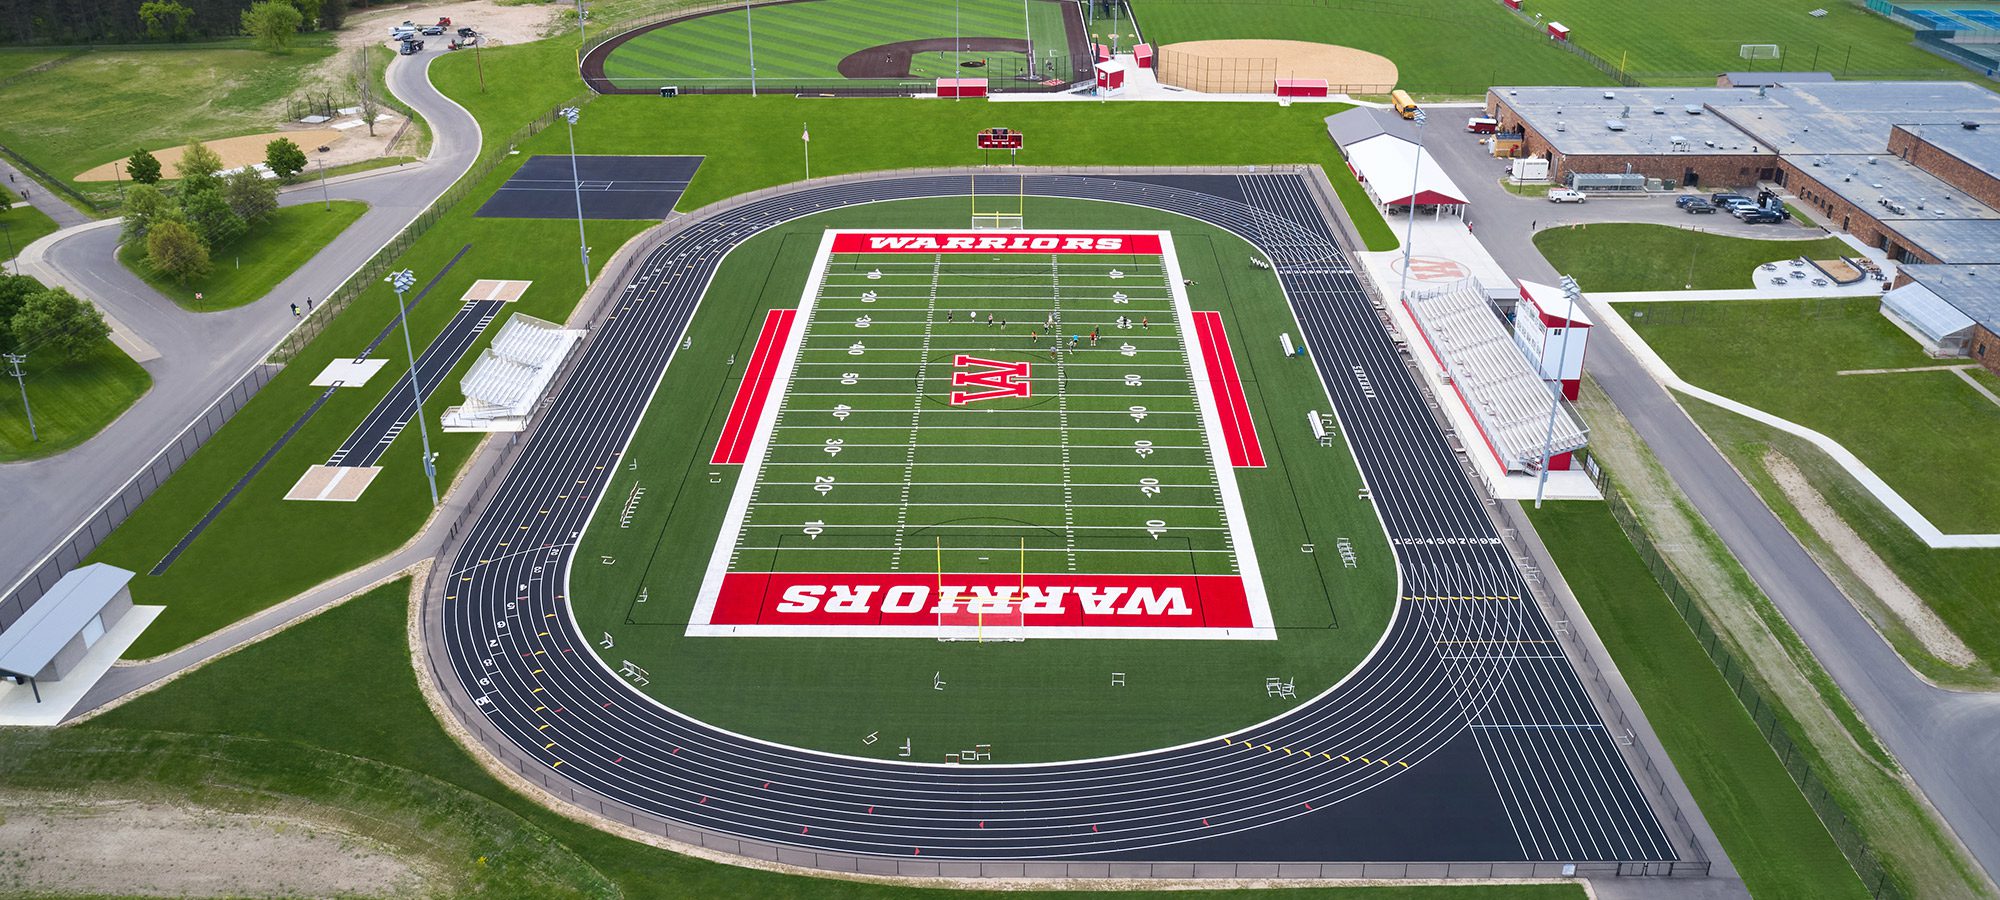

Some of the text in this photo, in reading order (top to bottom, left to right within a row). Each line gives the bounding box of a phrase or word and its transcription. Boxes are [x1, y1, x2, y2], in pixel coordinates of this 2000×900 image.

[869, 236, 1122, 250] WARRIORS
[861, 293, 877, 303] 20
[1112, 293, 1128, 304] 20
[854, 317, 871, 328] 30
[848, 343, 865, 355] 40
[1120, 345, 1137, 357] 40
[840, 372, 859, 385] 50
[950, 354, 1032, 405] W
[1124, 374, 1142, 386] 50
[832, 404, 851, 417] 40
[1129, 406, 1148, 419] 40
[823, 438, 844, 453] 30
[1134, 440, 1154, 454] 30
[814, 476, 835, 492] 20
[1139, 478, 1160, 493] 20
[803, 520, 824, 535] 10
[1146, 519, 1167, 535] 10
[520, 584, 528, 592] 4
[776, 583, 1192, 616] WARRIORS
[506, 602, 516, 610] 5
[496, 620, 506, 628] 6
[490, 639, 498, 648] 7
[483, 658, 492, 666] 8
[480, 678, 490, 686] 9
[475, 696, 490, 706] 10
